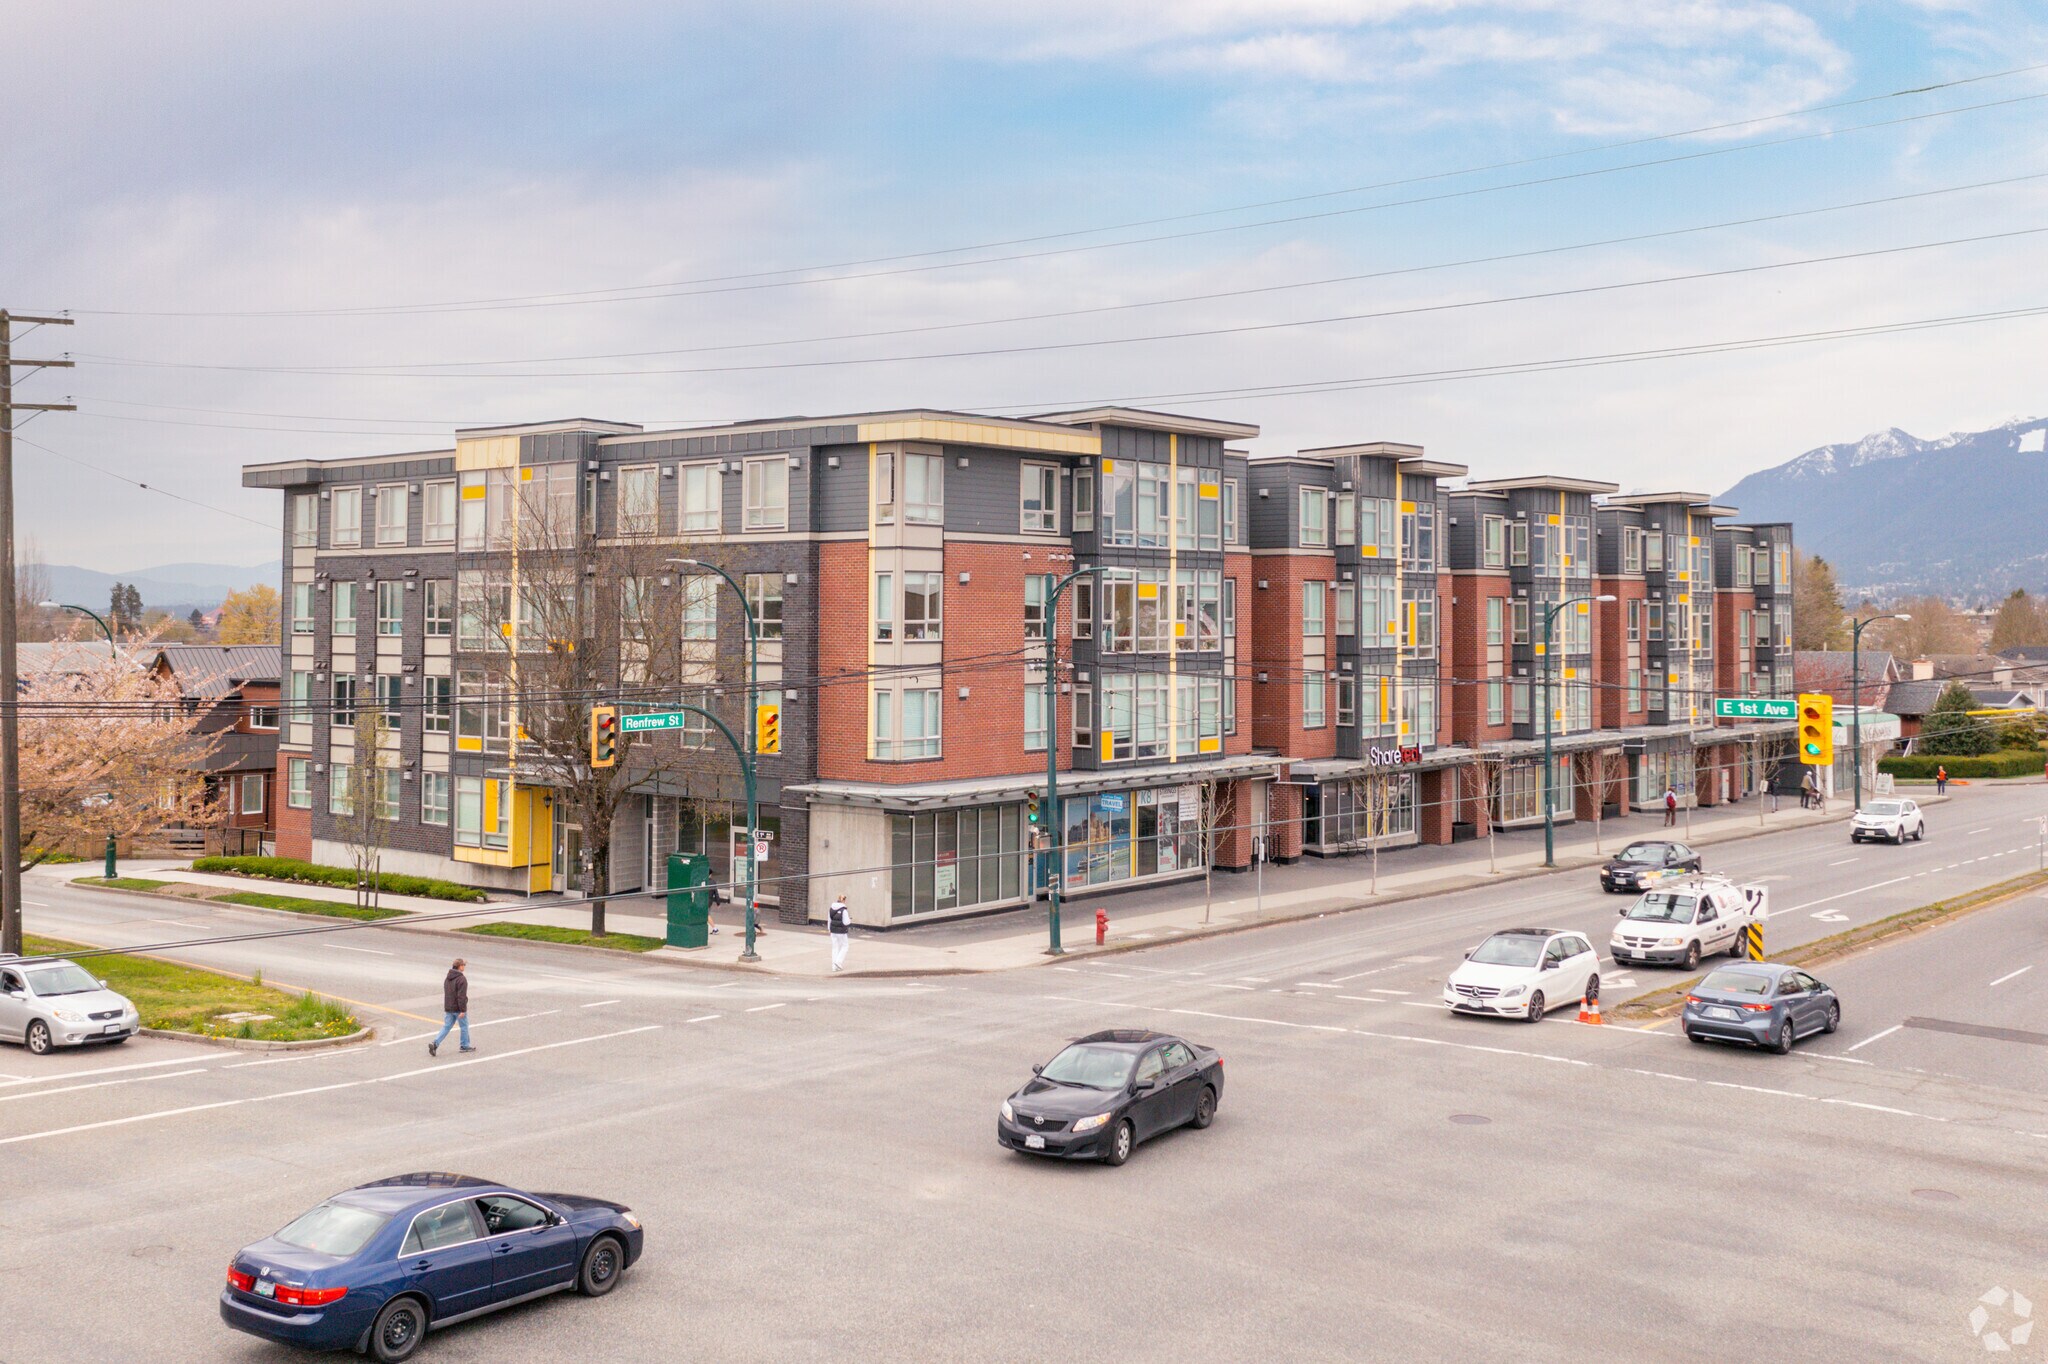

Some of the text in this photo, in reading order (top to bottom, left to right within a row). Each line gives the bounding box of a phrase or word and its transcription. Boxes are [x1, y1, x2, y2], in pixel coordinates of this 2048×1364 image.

[1723, 702, 1789, 715] E 1st Ave
[626, 715, 679, 729] Renfrew St
[1102, 799, 1122, 807] TRAVEL
